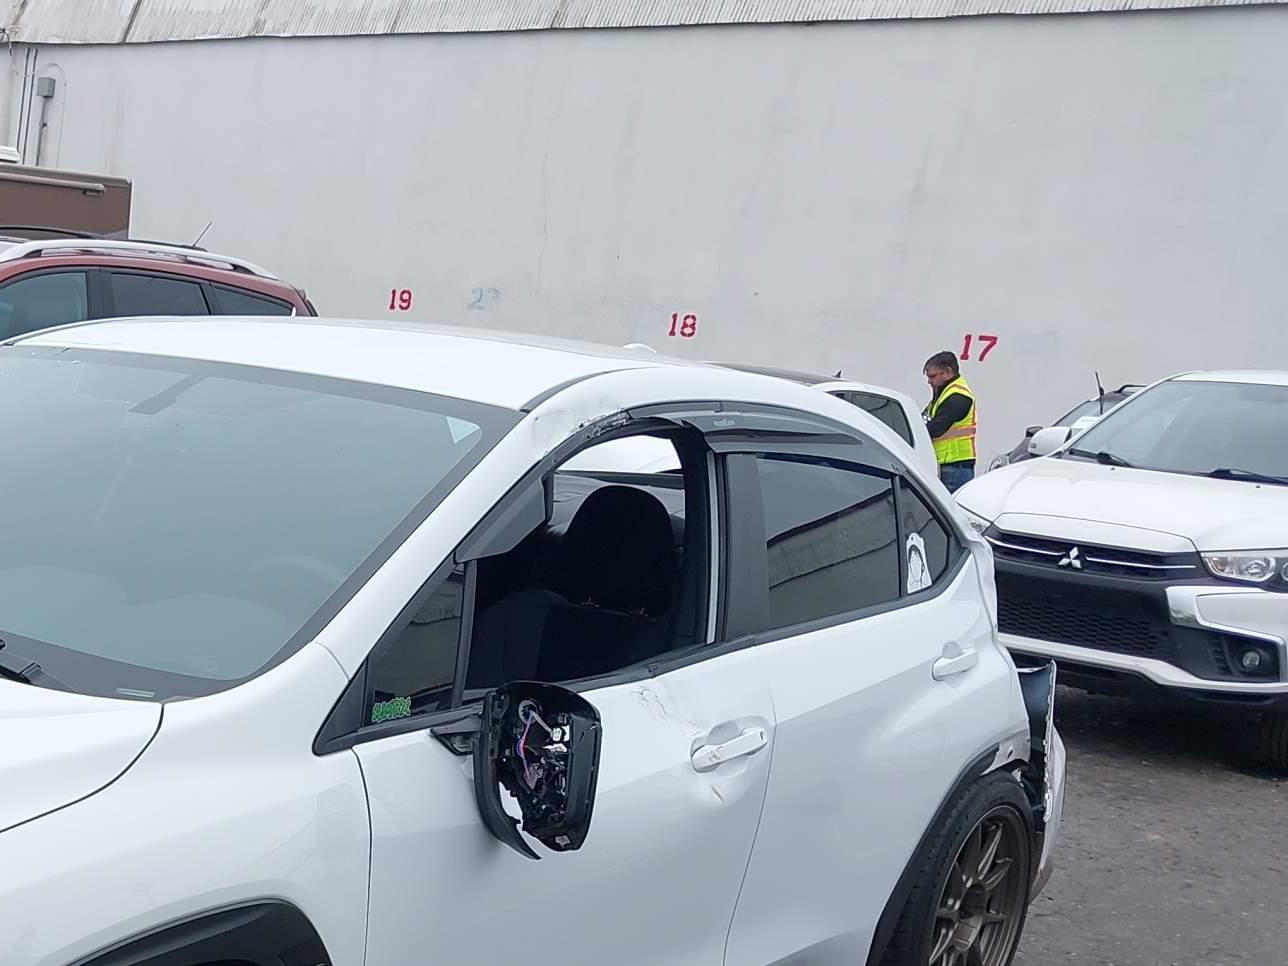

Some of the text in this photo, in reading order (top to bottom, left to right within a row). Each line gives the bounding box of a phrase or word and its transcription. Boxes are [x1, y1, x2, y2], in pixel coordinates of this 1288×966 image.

[389, 288, 412, 311] 19
[668, 313, 697, 338] 18
[960, 334, 998, 362] 17
